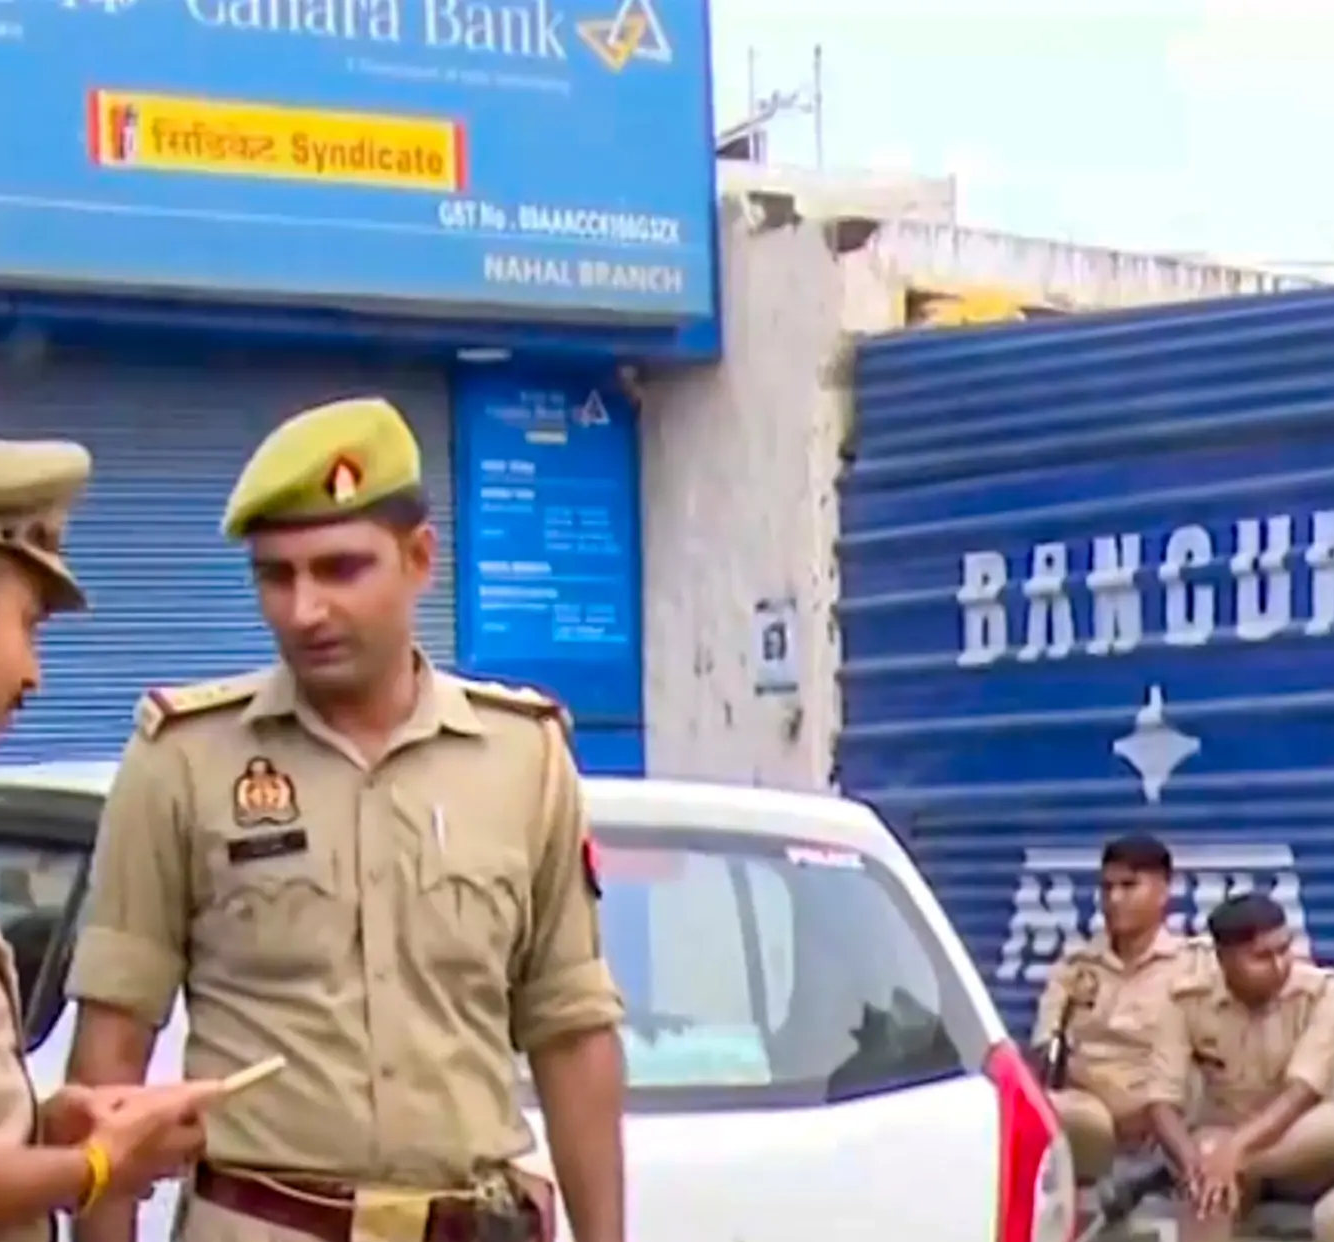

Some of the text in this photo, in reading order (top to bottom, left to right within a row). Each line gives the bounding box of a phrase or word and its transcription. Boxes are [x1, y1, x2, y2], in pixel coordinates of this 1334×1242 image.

[424, 0, 567, 59] Bank
[484, 255, 682, 293] NAHAL BRANCH
